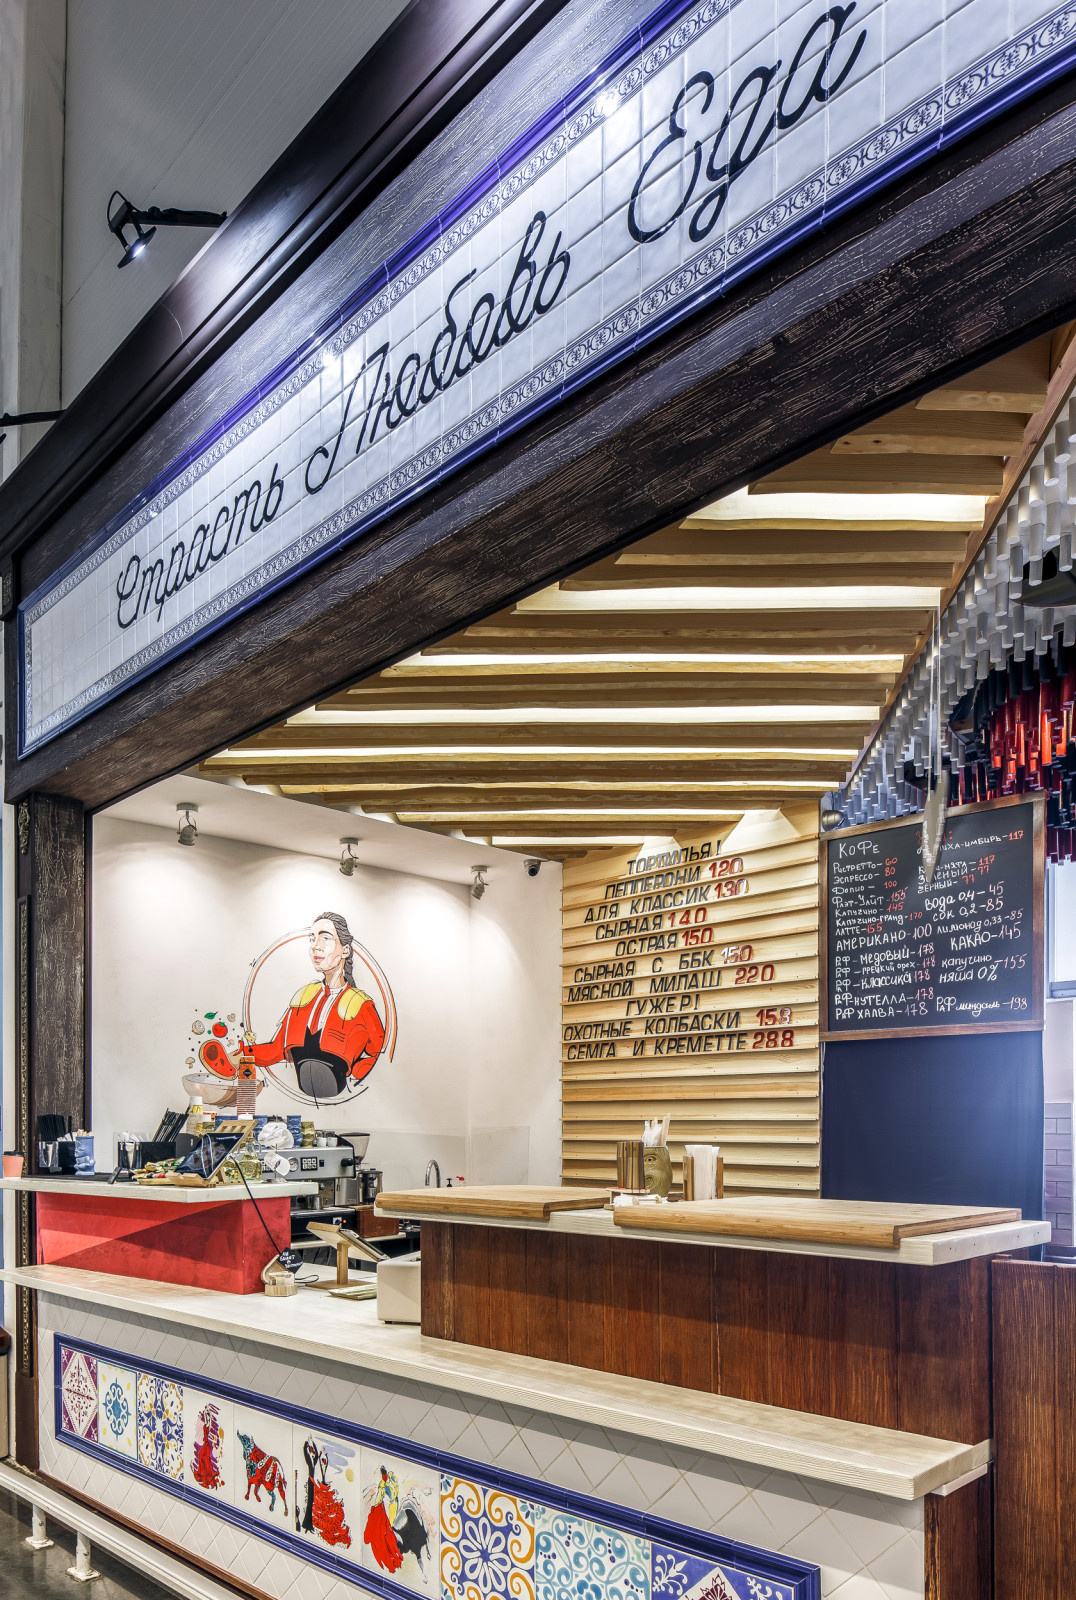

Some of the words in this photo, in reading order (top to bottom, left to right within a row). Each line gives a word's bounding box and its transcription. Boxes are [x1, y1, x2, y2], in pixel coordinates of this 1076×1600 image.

[116, 462, 285, 629] Страсть
[305, 210, 571, 495] Любовь
[627, 1, 867, 243] Еда
[885, 857, 897, 866] 60
[884, 867, 896, 876] 80
[978, 865, 989, 875] 77
[604, 865, 701, 900] ПЕППЕРОНИ
[708, 857, 743, 878] 120
[884, 880, 897, 888] 100
[962, 874, 975, 885] 77
[989, 881, 1005, 896] 45
[584, 903, 619, 923] АЛЯ
[630, 885, 711, 915] КЛАССИК
[714, 878, 749, 899] 130
[595, 914, 663, 940] СЫРНАЯ
[667, 907, 707, 928] 140
[912, 923, 932, 940] 100
[615, 933, 677, 956] ОСТРАЯ
[681, 927, 713, 947] 150
[917, 942, 935, 958] 178
[574, 961, 636, 983] СЫРНАЯ
[652, 957, 663, 974] С
[679, 950, 715, 970] ББК
[720, 945, 753, 964] 150
[922, 955, 936, 968] 178
[567, 980, 633, 1003] МЯСНОЙ
[650, 970, 722, 994] МИЛАШ
[734, 964, 775, 985] 220
[914, 969, 930, 983] 178
[914, 987, 934, 1001] 178
[904, 1002, 928, 1016] 178
[563, 1021, 633, 1041] ОХОТНЫЕ
[644, 1012, 740, 1035] КОЛБАСКИ
[756, 1007, 792, 1027] 158
[567, 1042, 617, 1060] СЕМГА
[633, 1040, 646, 1056] И
[654, 1033, 748, 1055] КРЕМЕТТЕ
[752, 1029, 794, 1050] 288
